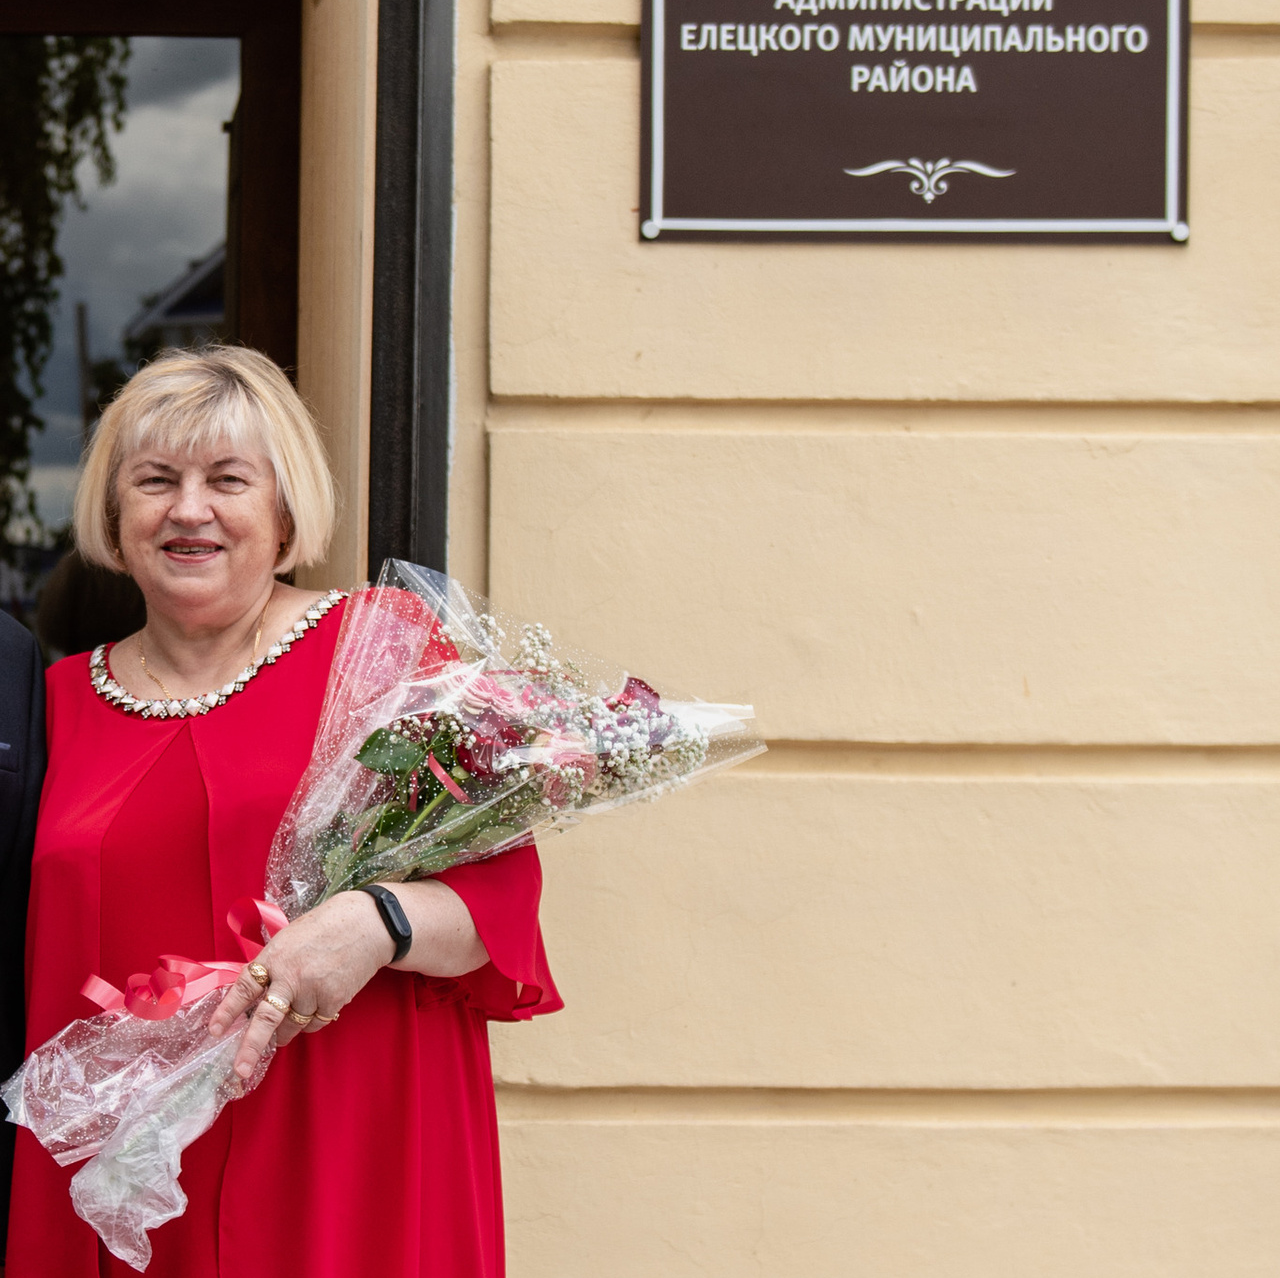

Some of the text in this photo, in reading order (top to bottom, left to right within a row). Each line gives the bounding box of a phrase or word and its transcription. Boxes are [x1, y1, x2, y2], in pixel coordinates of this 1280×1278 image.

[681, 24, 1148, 57] ЕЛЕЦКОГО МУНИЦИПАЛЬНОГО
[852, 60, 977, 92] РАЙОНА
